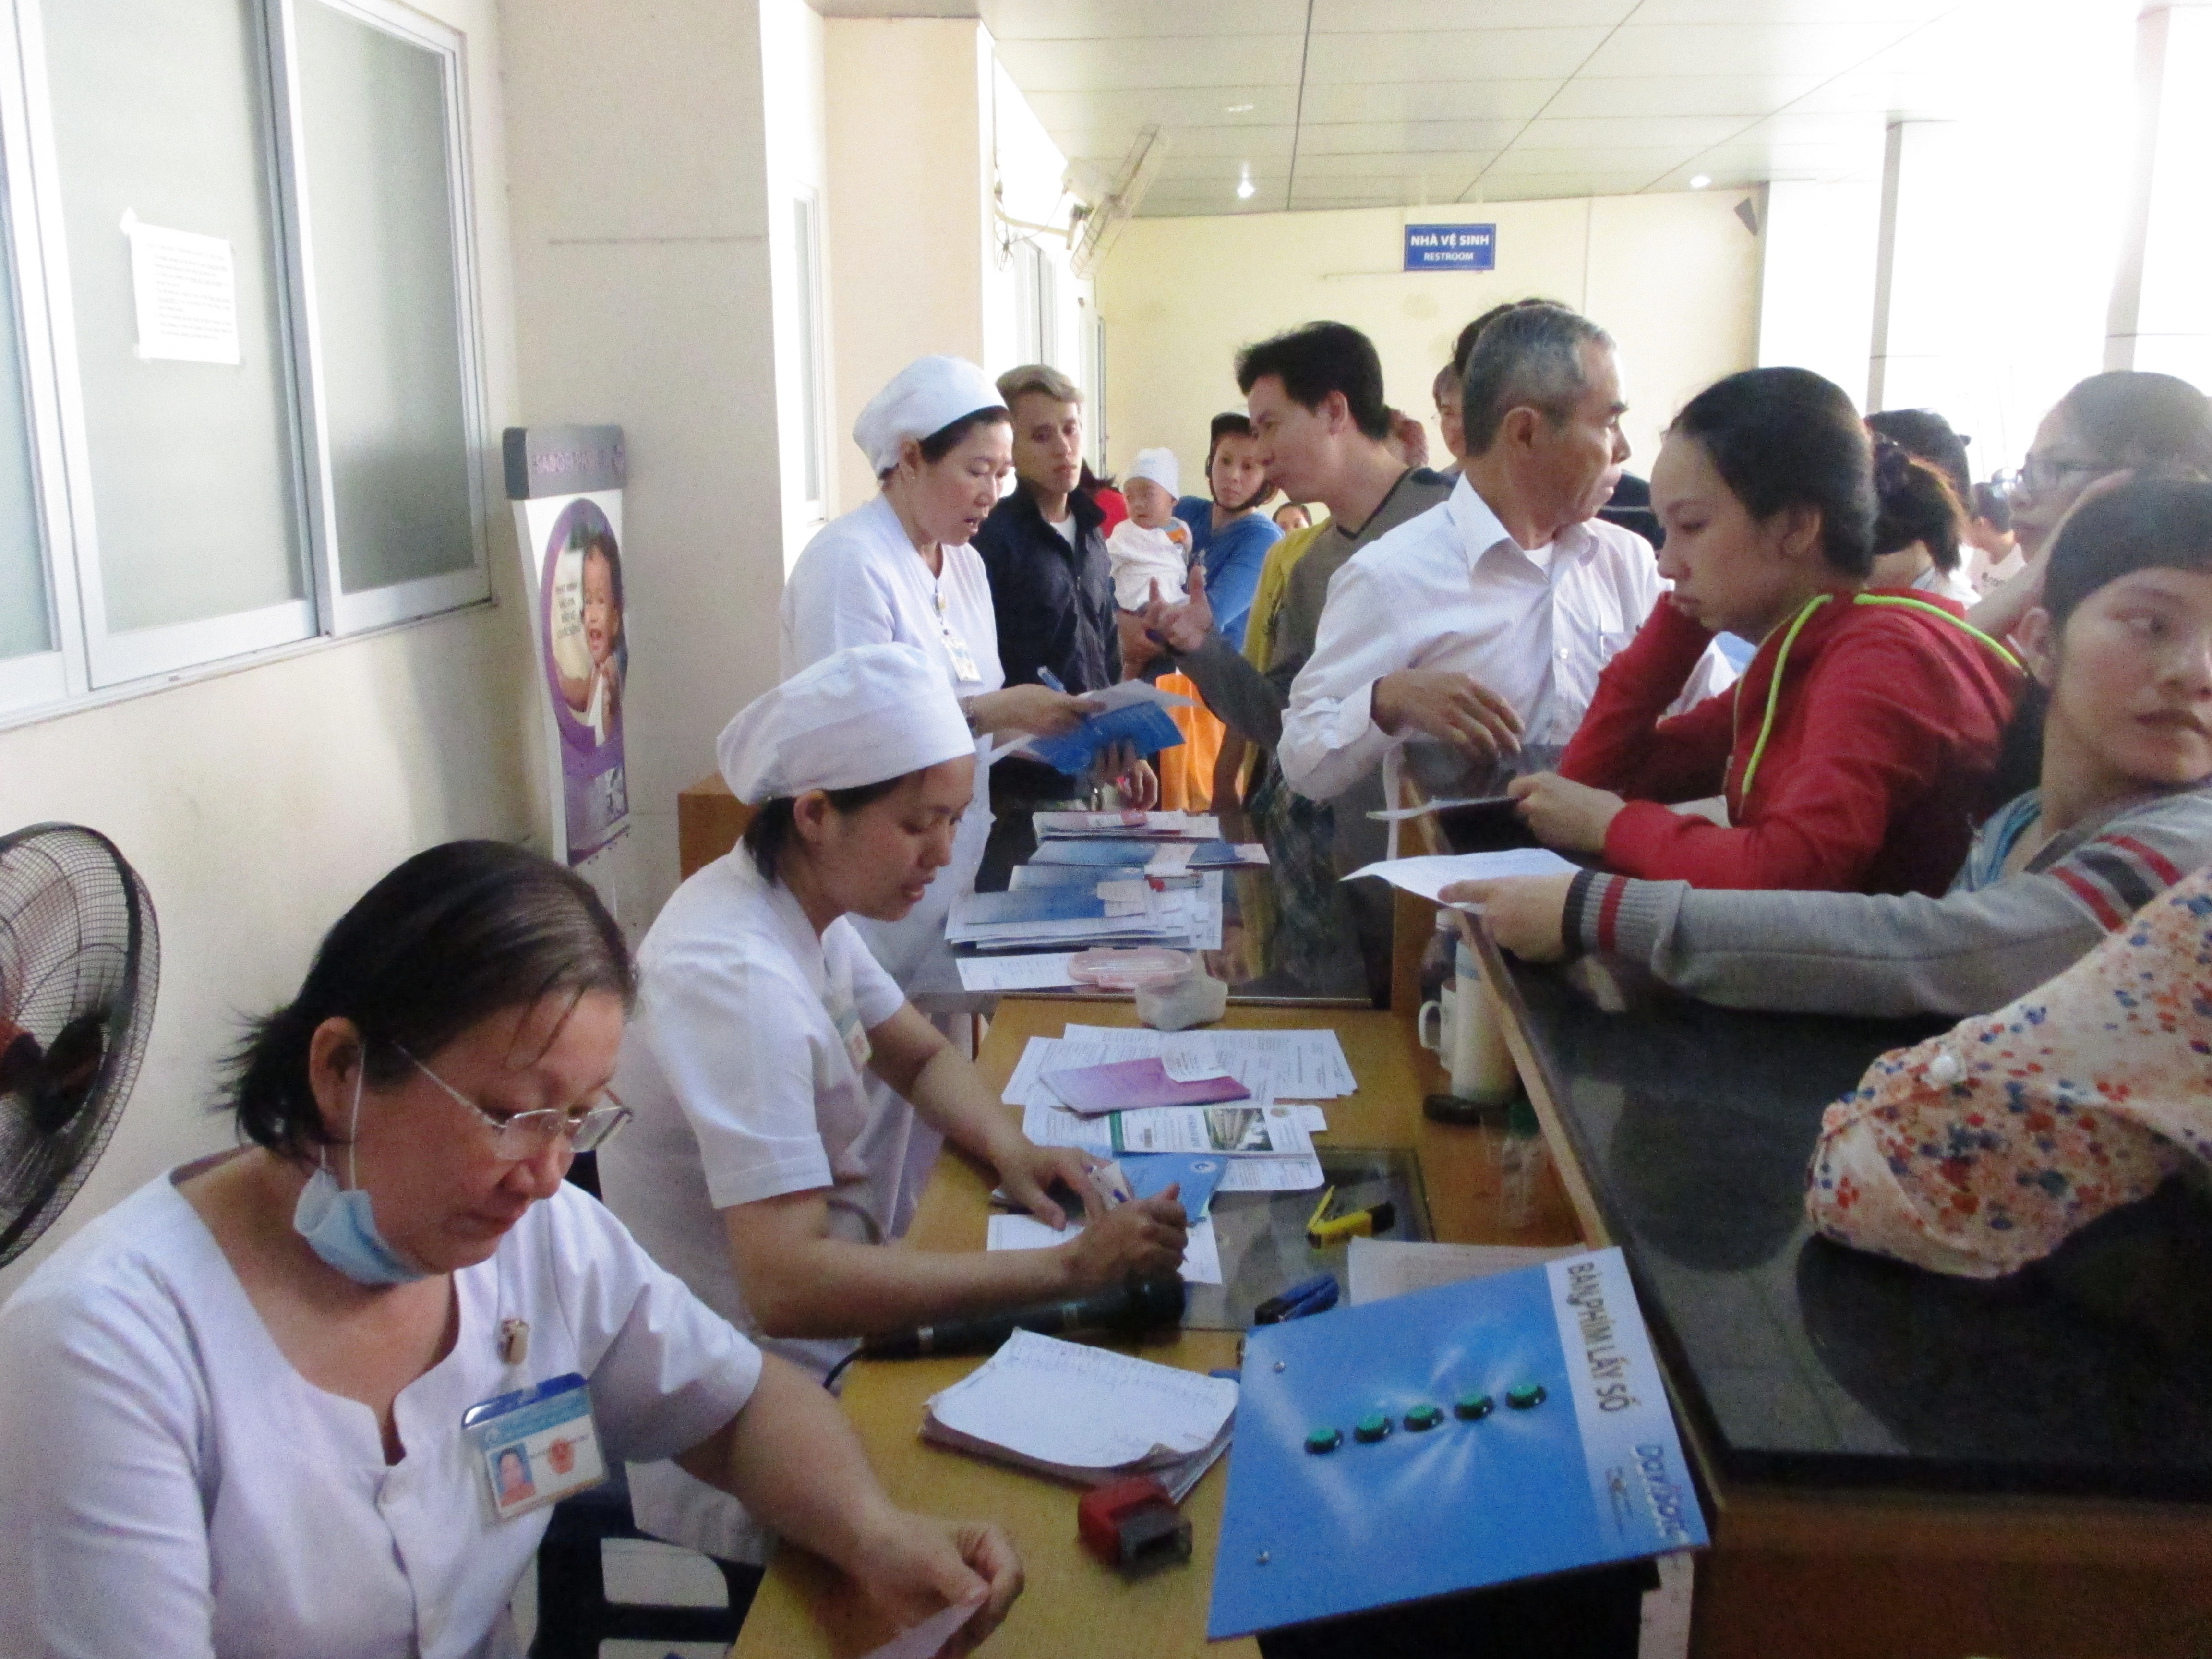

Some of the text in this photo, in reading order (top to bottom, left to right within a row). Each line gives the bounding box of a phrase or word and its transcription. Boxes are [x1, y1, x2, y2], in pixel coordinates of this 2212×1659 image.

[1411, 232, 1489, 249] NHÀ VỆ SINH
[1424, 252, 1474, 261] RESTROOM
[1595, 1383, 1642, 1412] SỐ
